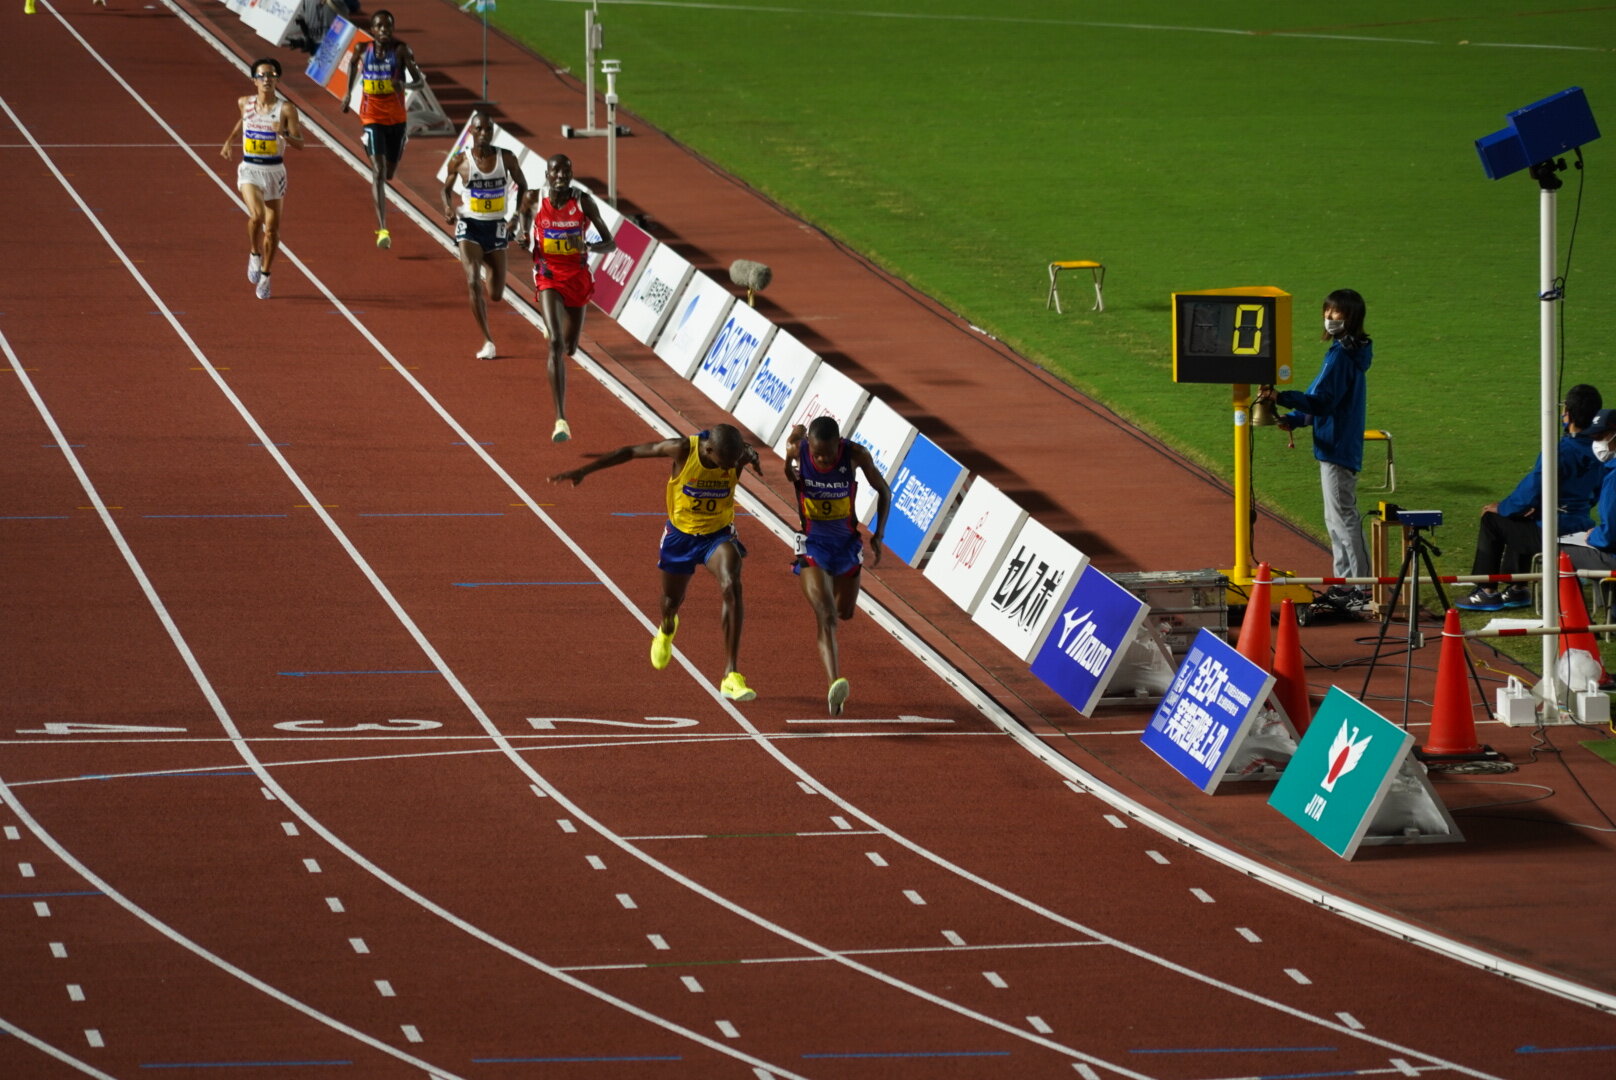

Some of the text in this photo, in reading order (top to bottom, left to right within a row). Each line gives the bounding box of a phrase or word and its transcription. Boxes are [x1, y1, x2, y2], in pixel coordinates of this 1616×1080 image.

[252, 141, 267, 151] 14
[484, 200, 492, 210] 8
[1232, 304, 1264, 355] 0
[750, 356, 795, 414] Panasonic
[805, 479, 849, 489] SUBARU
[691, 499, 717, 512] 20
[822, 501, 832, 515] 9
[952, 526, 987, 572] FUJITSU
[990, 545, 1065, 634] セレスポ
[1187, 656, 1229, 706] 全日本
